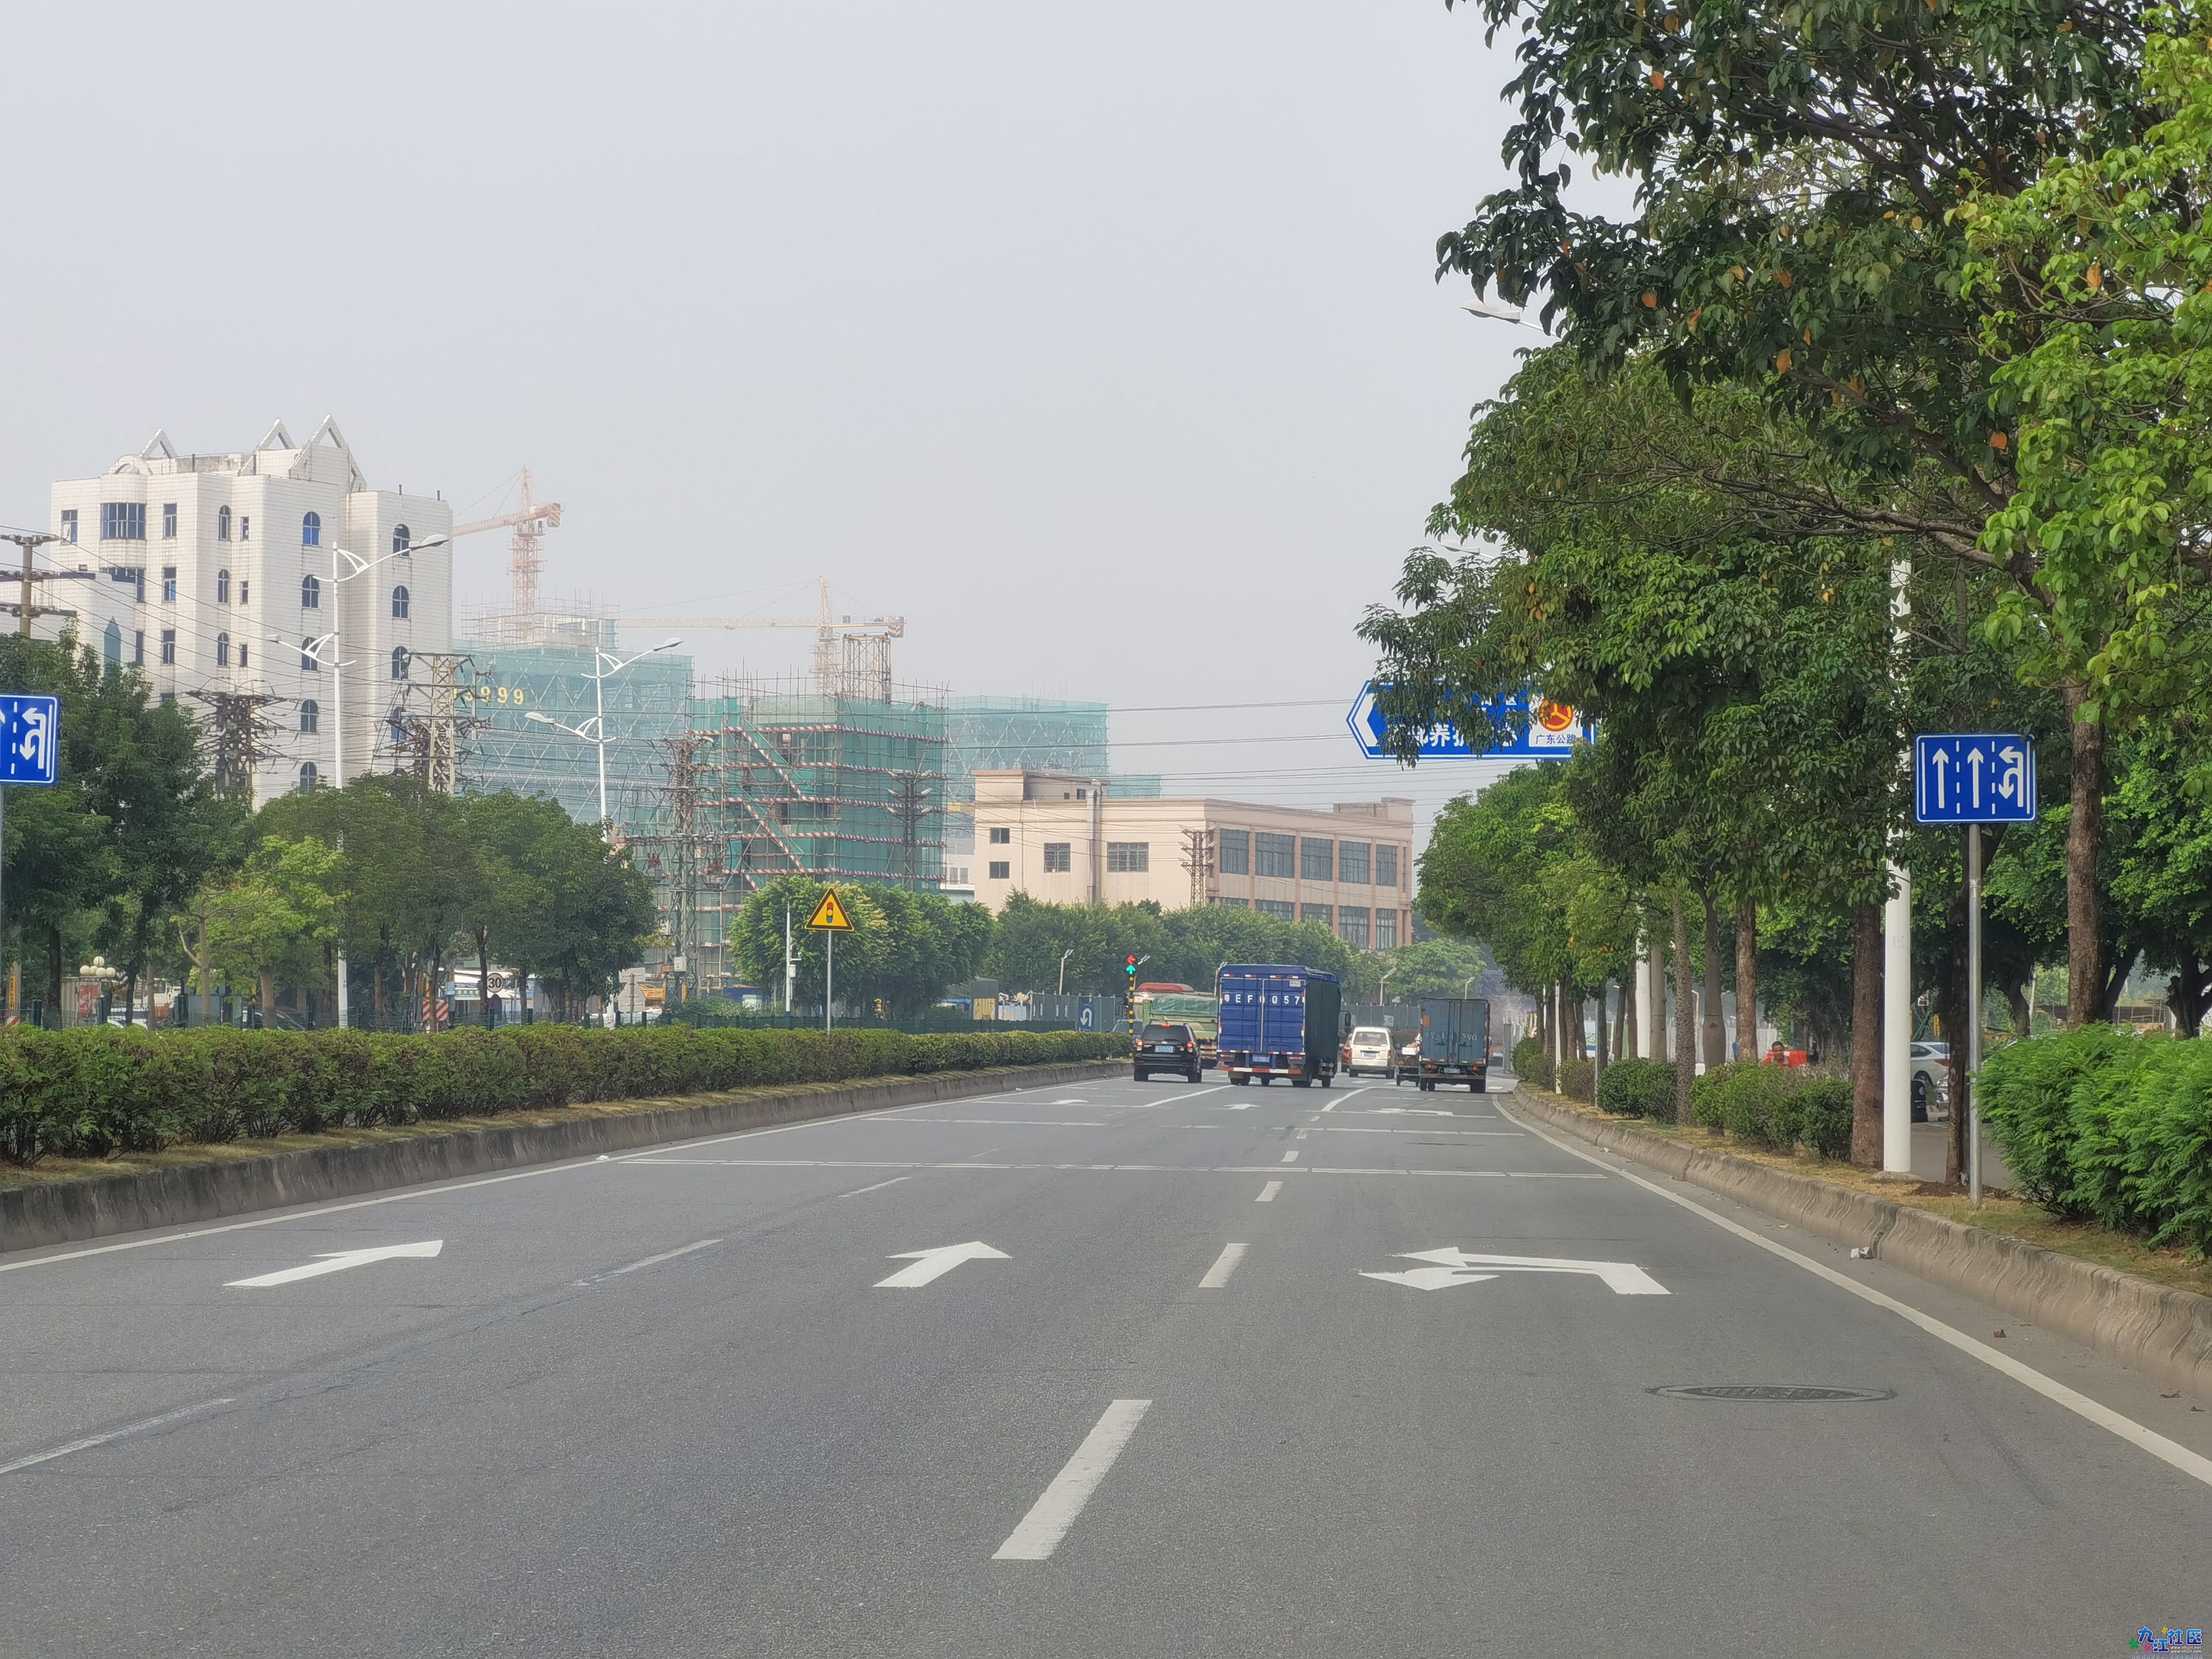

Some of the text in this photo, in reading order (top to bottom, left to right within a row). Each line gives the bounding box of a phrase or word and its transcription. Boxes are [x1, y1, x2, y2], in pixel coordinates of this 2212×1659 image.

[1536, 733, 1577, 745] 广东公路
[488, 977, 502, 988] 30
